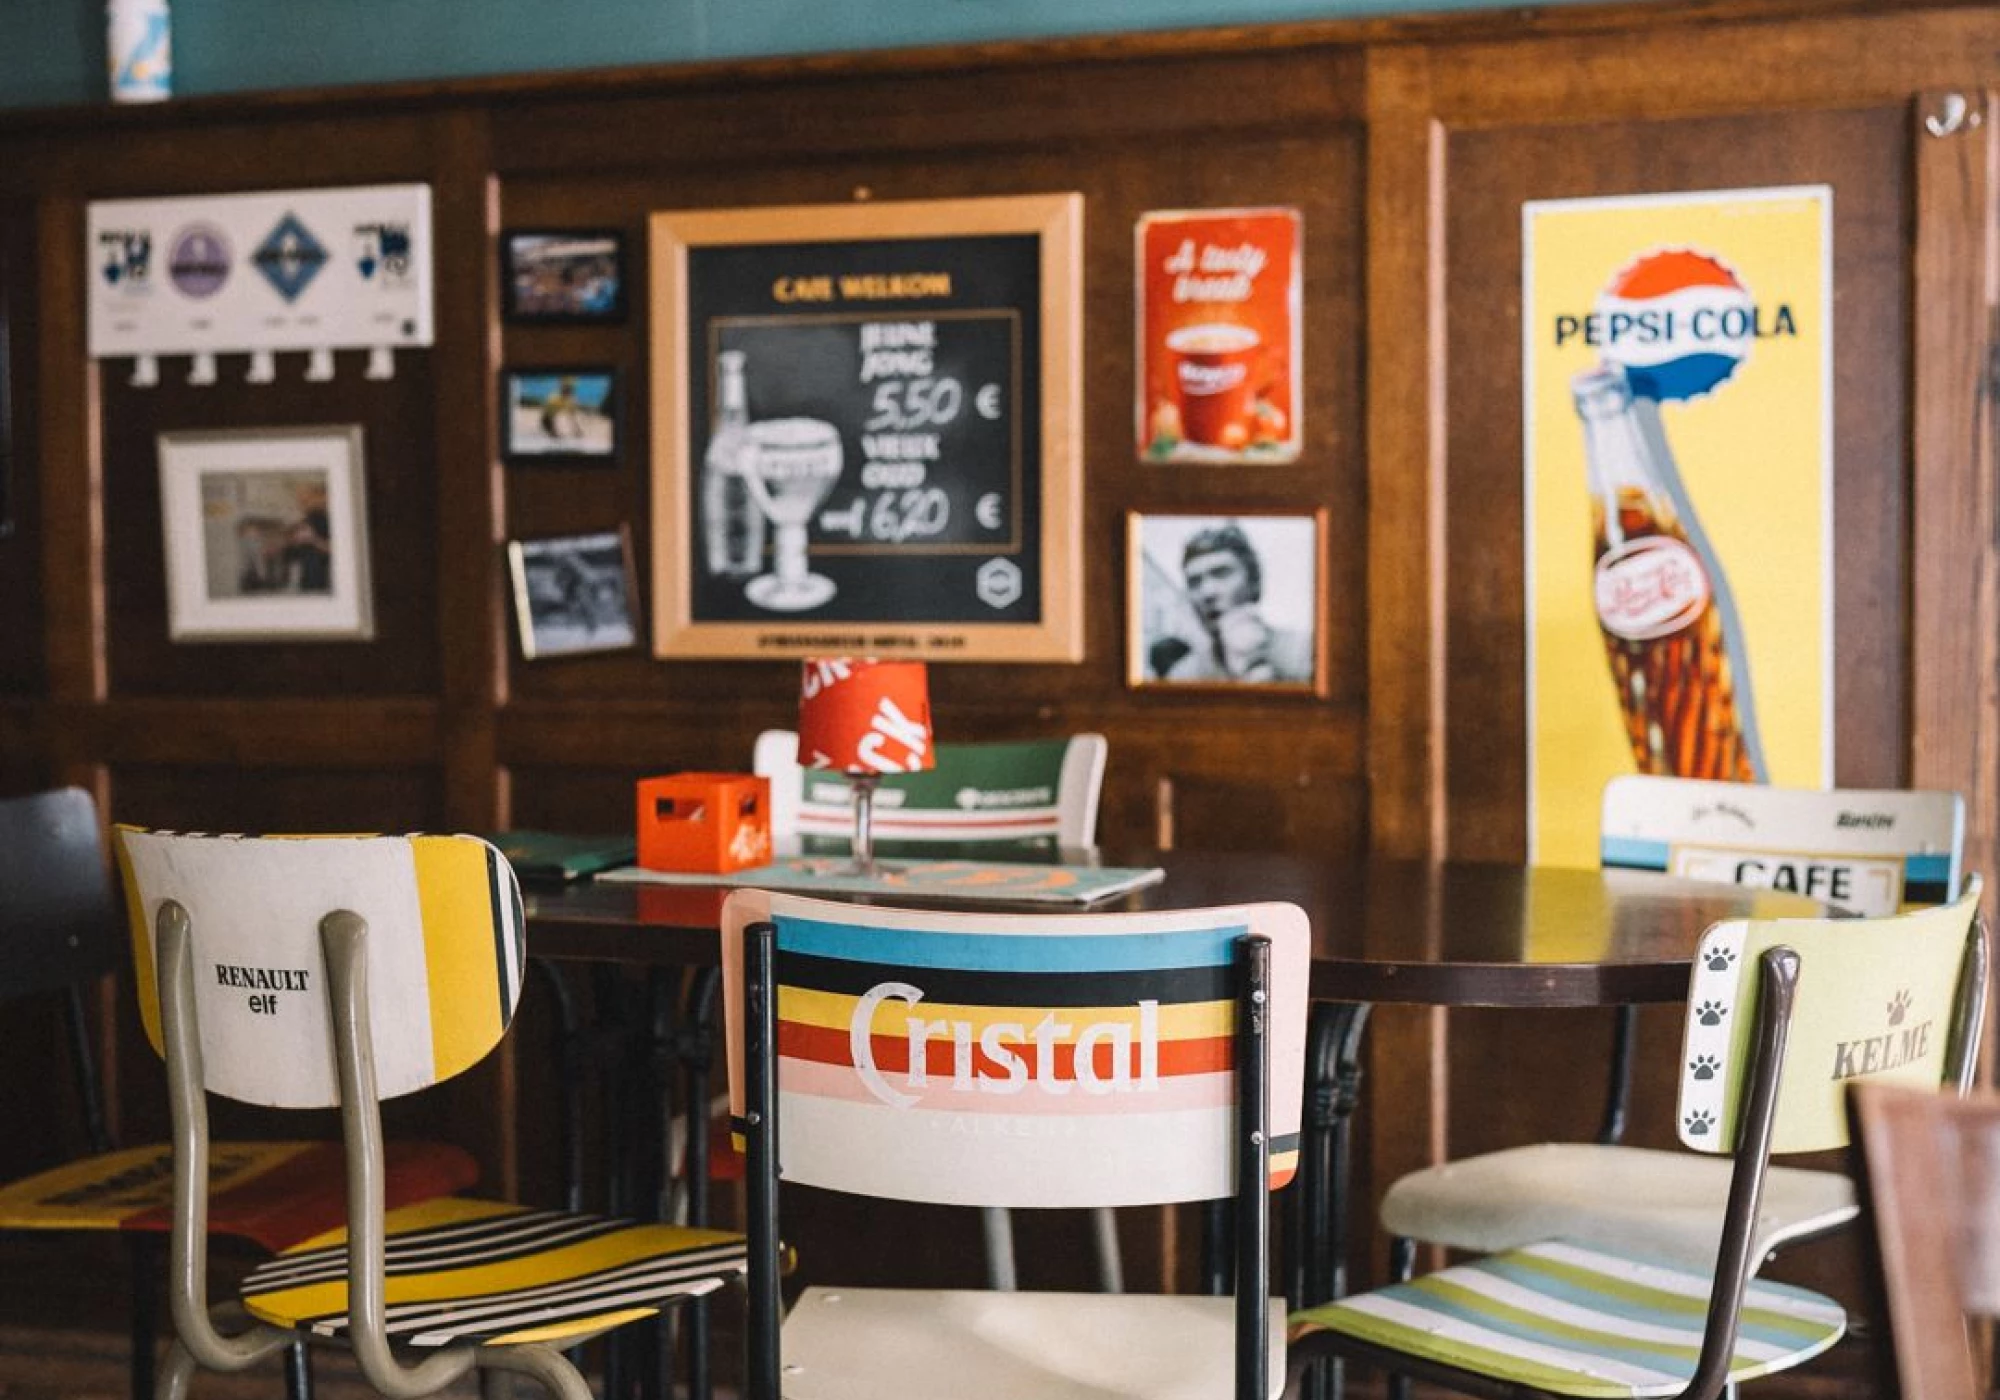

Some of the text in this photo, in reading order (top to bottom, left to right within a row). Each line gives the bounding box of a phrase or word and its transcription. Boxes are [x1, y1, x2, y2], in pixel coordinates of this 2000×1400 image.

[1735, 858, 1852, 900] CAFE
[215, 964, 309, 991] RENAULT
[248, 994, 278, 1015] elf
[851, 981, 1160, 1110] Cristal
[1831, 1020, 1932, 1080] KELME
